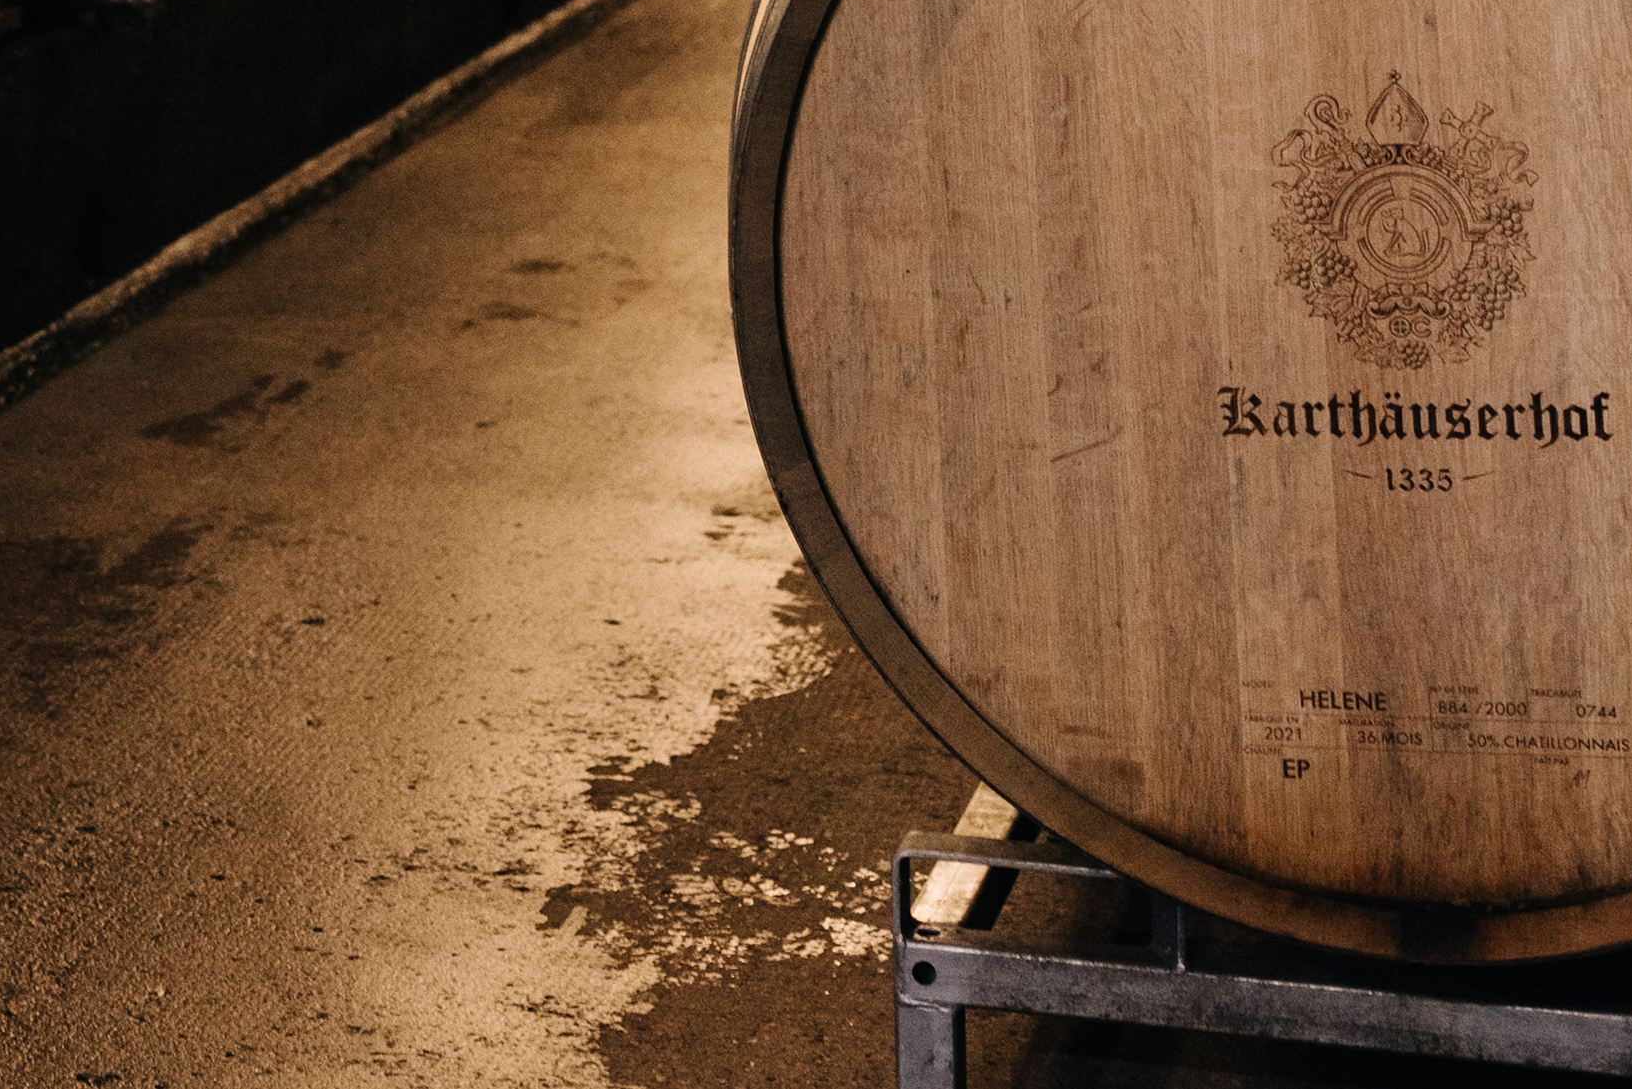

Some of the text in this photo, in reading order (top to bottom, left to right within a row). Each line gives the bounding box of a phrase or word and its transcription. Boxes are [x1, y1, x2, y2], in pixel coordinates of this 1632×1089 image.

[1217, 386, 1613, 449] Karthäuserhof
[1385, 466, 1454, 492] 1335
[1299, 690, 1387, 711] HELENE
[1438, 700, 1468, 715] 884
[1575, 704, 1617, 719] 0744
[1264, 726, 1302, 741] 2021
[1282, 759, 1311, 780] EP
